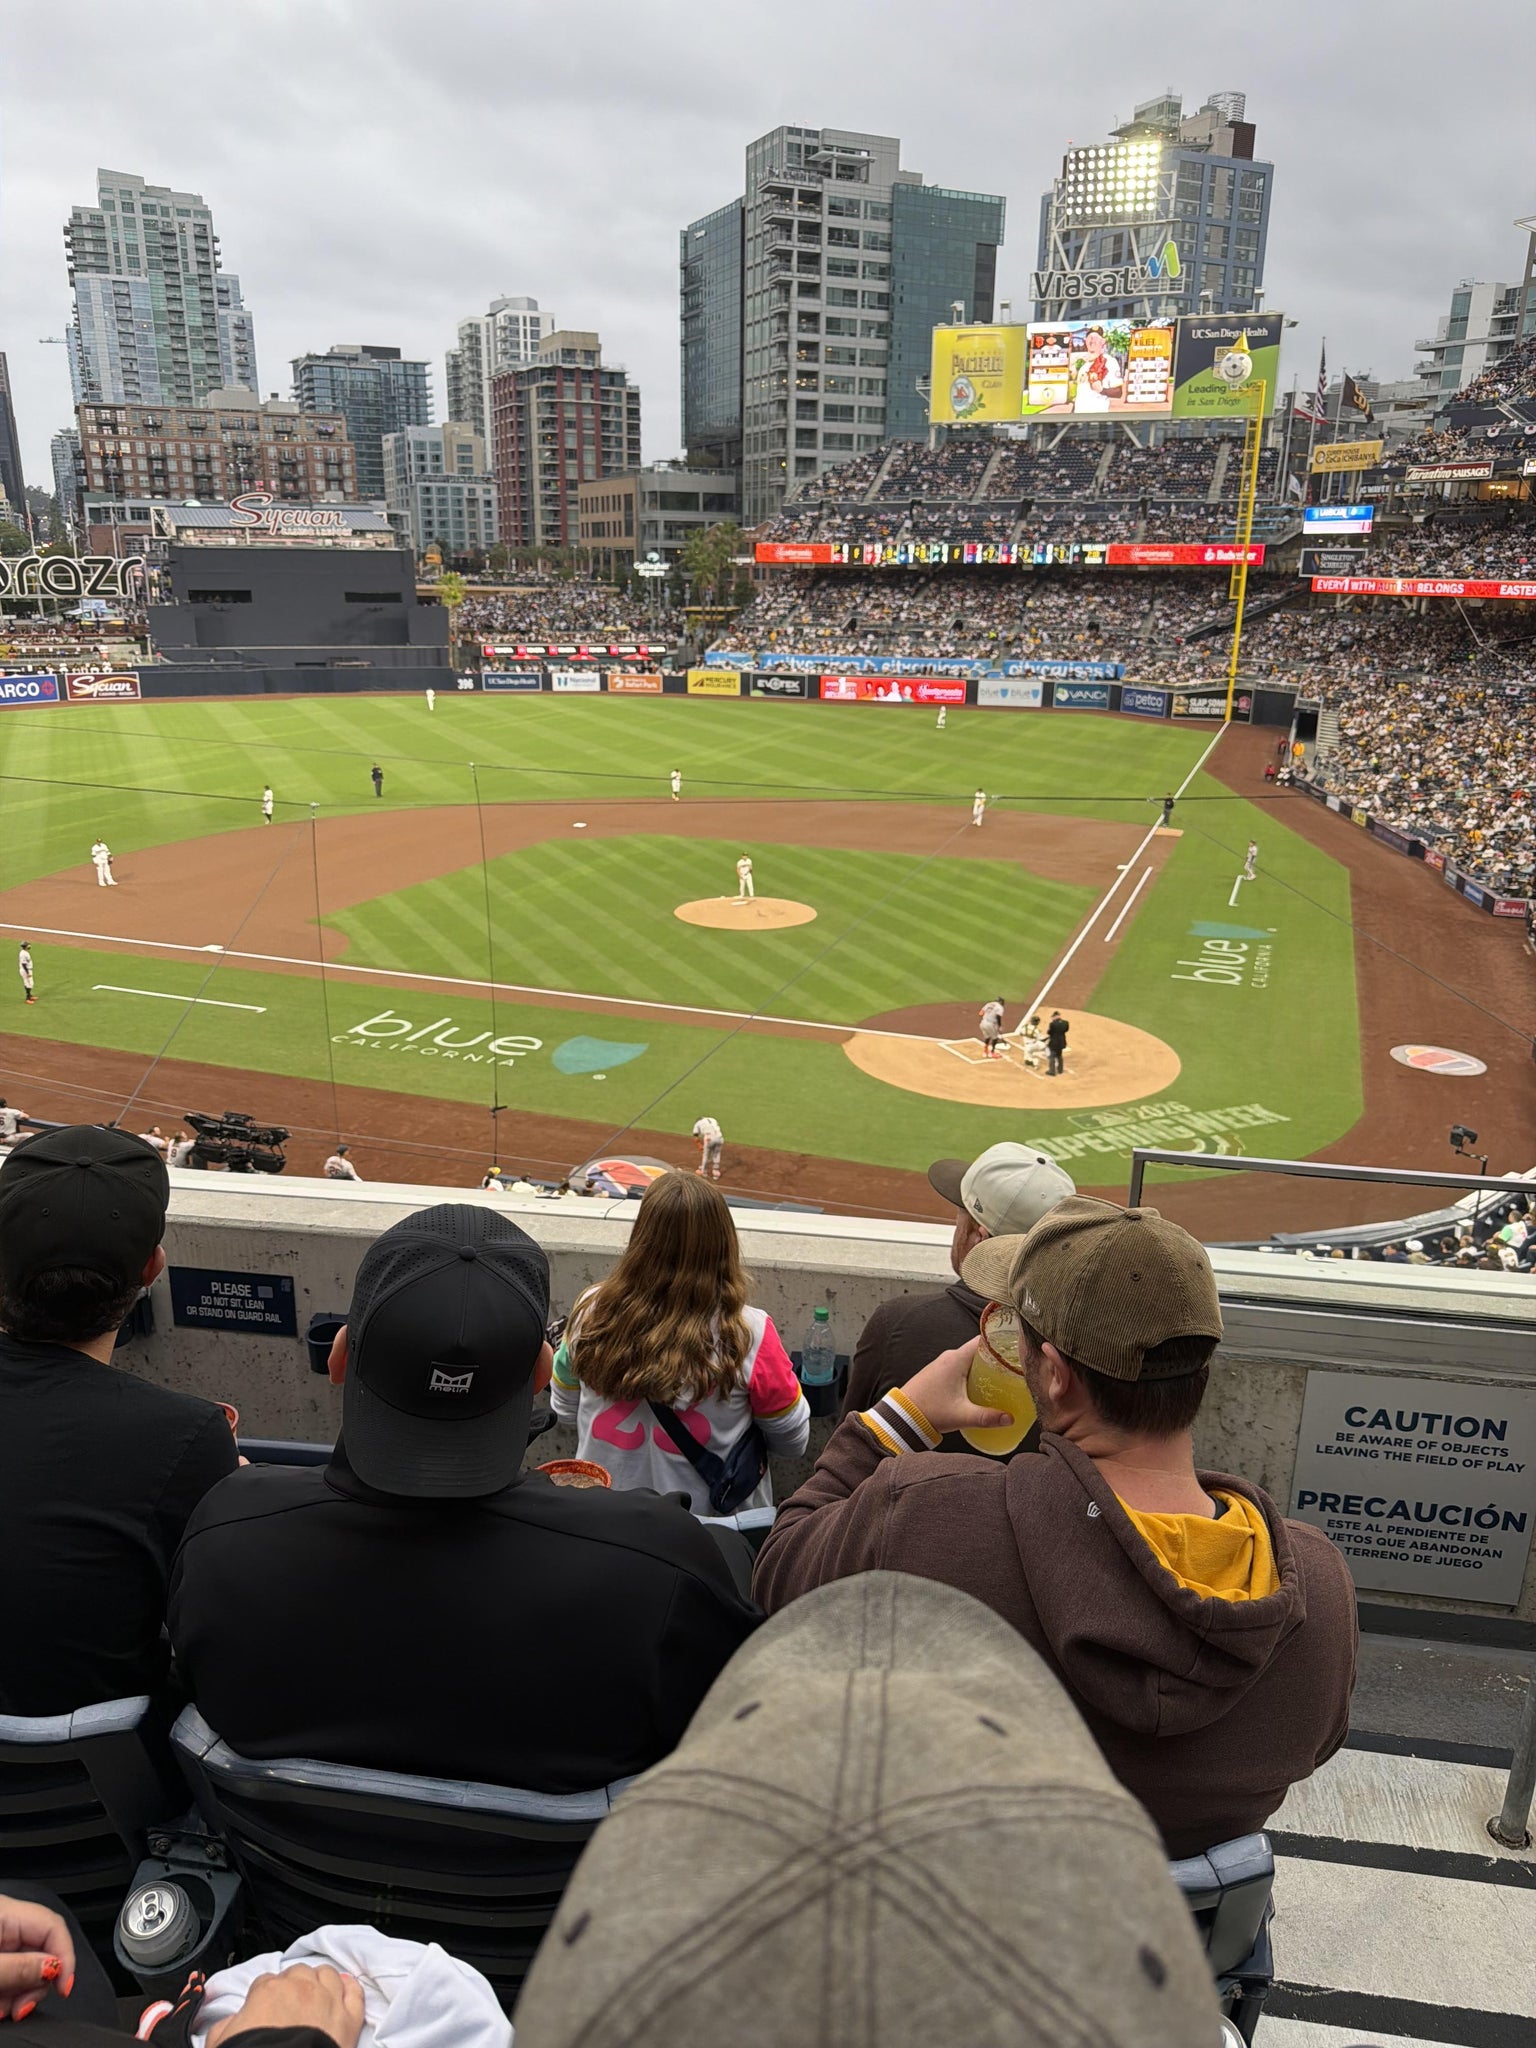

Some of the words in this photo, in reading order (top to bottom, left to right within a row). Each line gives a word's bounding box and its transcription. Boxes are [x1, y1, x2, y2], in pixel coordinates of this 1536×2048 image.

[1034, 266, 1133, 299] Viasat
[1188, 385, 1227, 395] Leading
[1407, 467, 1452, 480] Tarantino
[1452, 467, 1490, 478] SAUSAGES
[230, 492, 347, 535] Sycuan
[1351, 579, 1375, 591] WITH
[1417, 582, 1464, 594] BELONGS
[72, 676, 133, 697] Sycuan
[1134, 693, 1163, 708] petco
[1171, 939, 1248, 985] blue
[346, 1010, 543, 1056] blue
[331, 1035, 515, 1067] CALIFORNIA
[1129, 1101, 1191, 1120] 2026
[1024, 1118, 1196, 1162] OPENING
[1181, 1103, 1292, 1134] WEEK
[211, 1281, 252, 1297] PLEASE
[186, 1305, 198, 1315] OR
[199, 1307, 224, 1318] STAND
[224, 1309, 237, 1319] ON
[237, 1310, 264, 1322] GUARD
[264, 1312, 282, 1324] RAIL
[201, 1295, 213, 1305] DO
[213, 1296, 229, 1307] NOT
[244, 1299, 265, 1310] LEAN
[1344, 1406, 1508, 1441] CAUTION
[1335, 1432, 1355, 1443] BE
[1358, 1434, 1412, 1448] AWARE
[1416, 1439, 1438, 1450] OF
[1441, 1442, 1509, 1458] OBJECTS
[1315, 1444, 1379, 1459] LEAVING
[1384, 1451, 1412, 1462] THE
[1416, 1453, 1458, 1466] FIELD
[1462, 1458, 1484, 1469] OF
[1487, 1461, 1526, 1474] PLAY
[1297, 1489, 1528, 1533] PRECAUCIÓN
[1327, 1519, 1361, 1531] ESTE
[1364, 1523, 1383, 1533] AL
[1386, 1525, 1466, 1543] PENDIENTE
[1469, 1533, 1489, 1545] DE
[1344, 1546, 1409, 1562] TERRENO
[1413, 1553, 1432, 1564] DE
[1435, 1556, 1483, 1570] JUEGO
[1376, 1537, 1406, 1549] QUE
[1409, 1540, 1503, 1559] ABANDONAN
